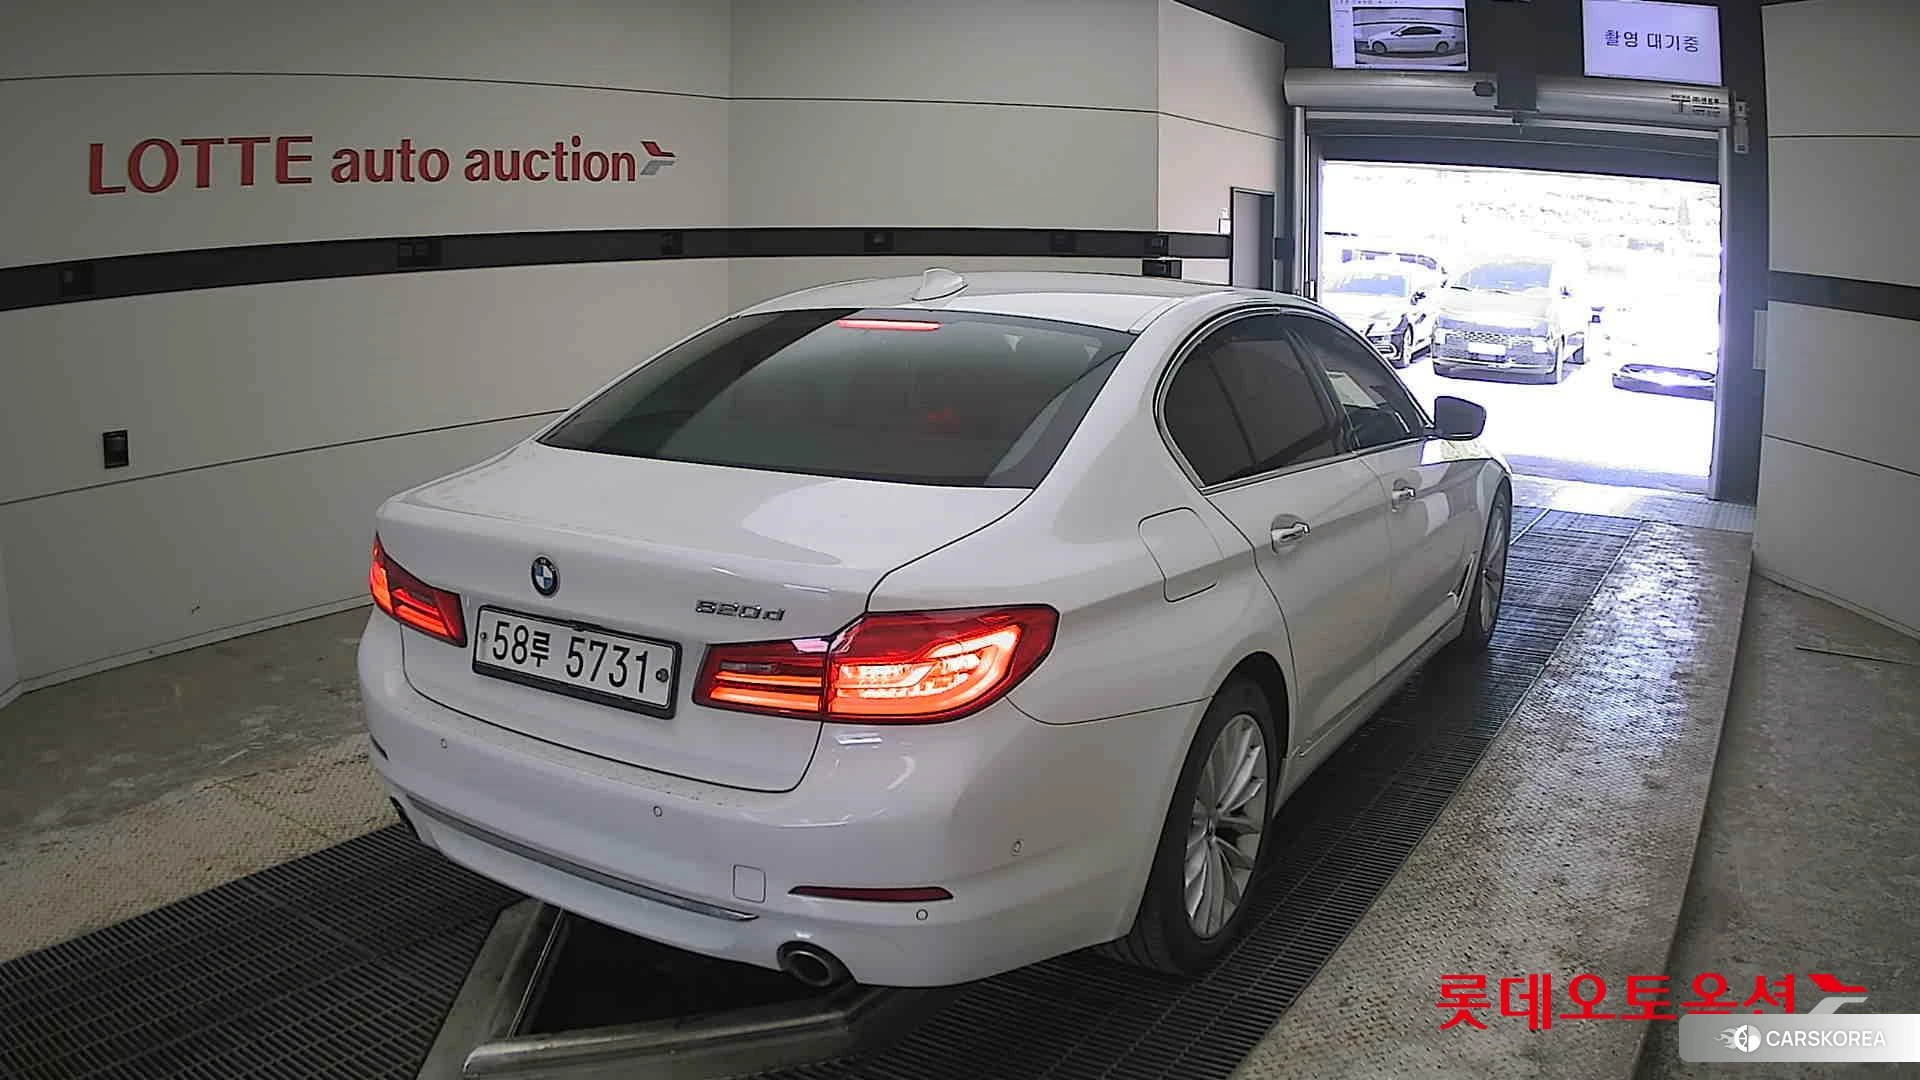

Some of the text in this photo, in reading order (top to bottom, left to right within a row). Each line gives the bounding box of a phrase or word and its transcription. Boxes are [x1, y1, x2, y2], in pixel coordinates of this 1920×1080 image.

[1604, 29, 1699, 53] 촬영 대기중
[89, 136, 637, 195] LOTTE auto auction
[492, 620, 649, 694] 58루 5731
